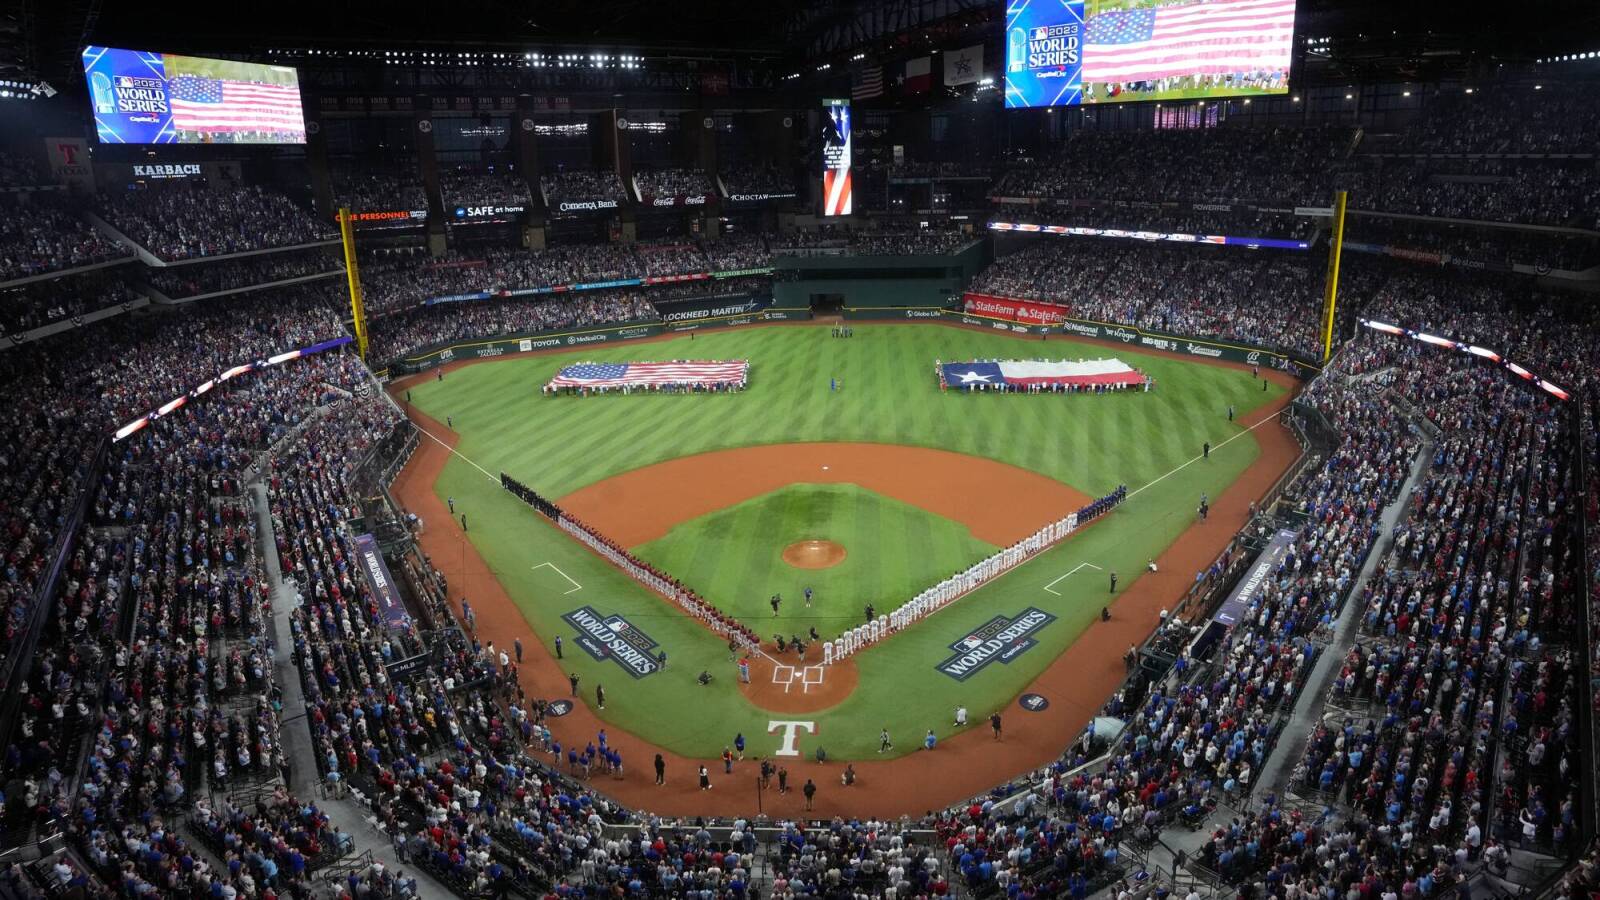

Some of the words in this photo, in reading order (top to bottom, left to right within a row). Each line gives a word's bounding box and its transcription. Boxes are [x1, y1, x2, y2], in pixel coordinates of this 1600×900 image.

[1048, 25, 1078, 36] 2023
[1029, 36, 1079, 54] WORLD
[1028, 49, 1079, 68] SERIES
[133, 79, 163, 88] 2023
[115, 88, 166, 101] WORLD
[118, 100, 168, 113] SERIES
[133, 164, 201, 176] KARBACH
[598, 200, 618, 208] Bank
[360, 210, 409, 220] PERSONNEL
[467, 206, 494, 216] SAFE
[664, 309, 709, 321] LOCKHEED
[711, 306, 744, 316] MARTIN
[1072, 323, 1099, 334] National
[1114, 328, 1137, 342] Kroger
[1142, 336, 1154, 345] BIG
[533, 338, 560, 347] TOYOTA
[440, 349, 454, 359] UTA
[572, 609, 616, 643] WORLD
[606, 639, 656, 674] SERIES
[945, 640, 1004, 675] WORLD
[997, 611, 1047, 643] SERIES
[400, 661, 416, 671] MLB
[767, 720, 817, 757] T
